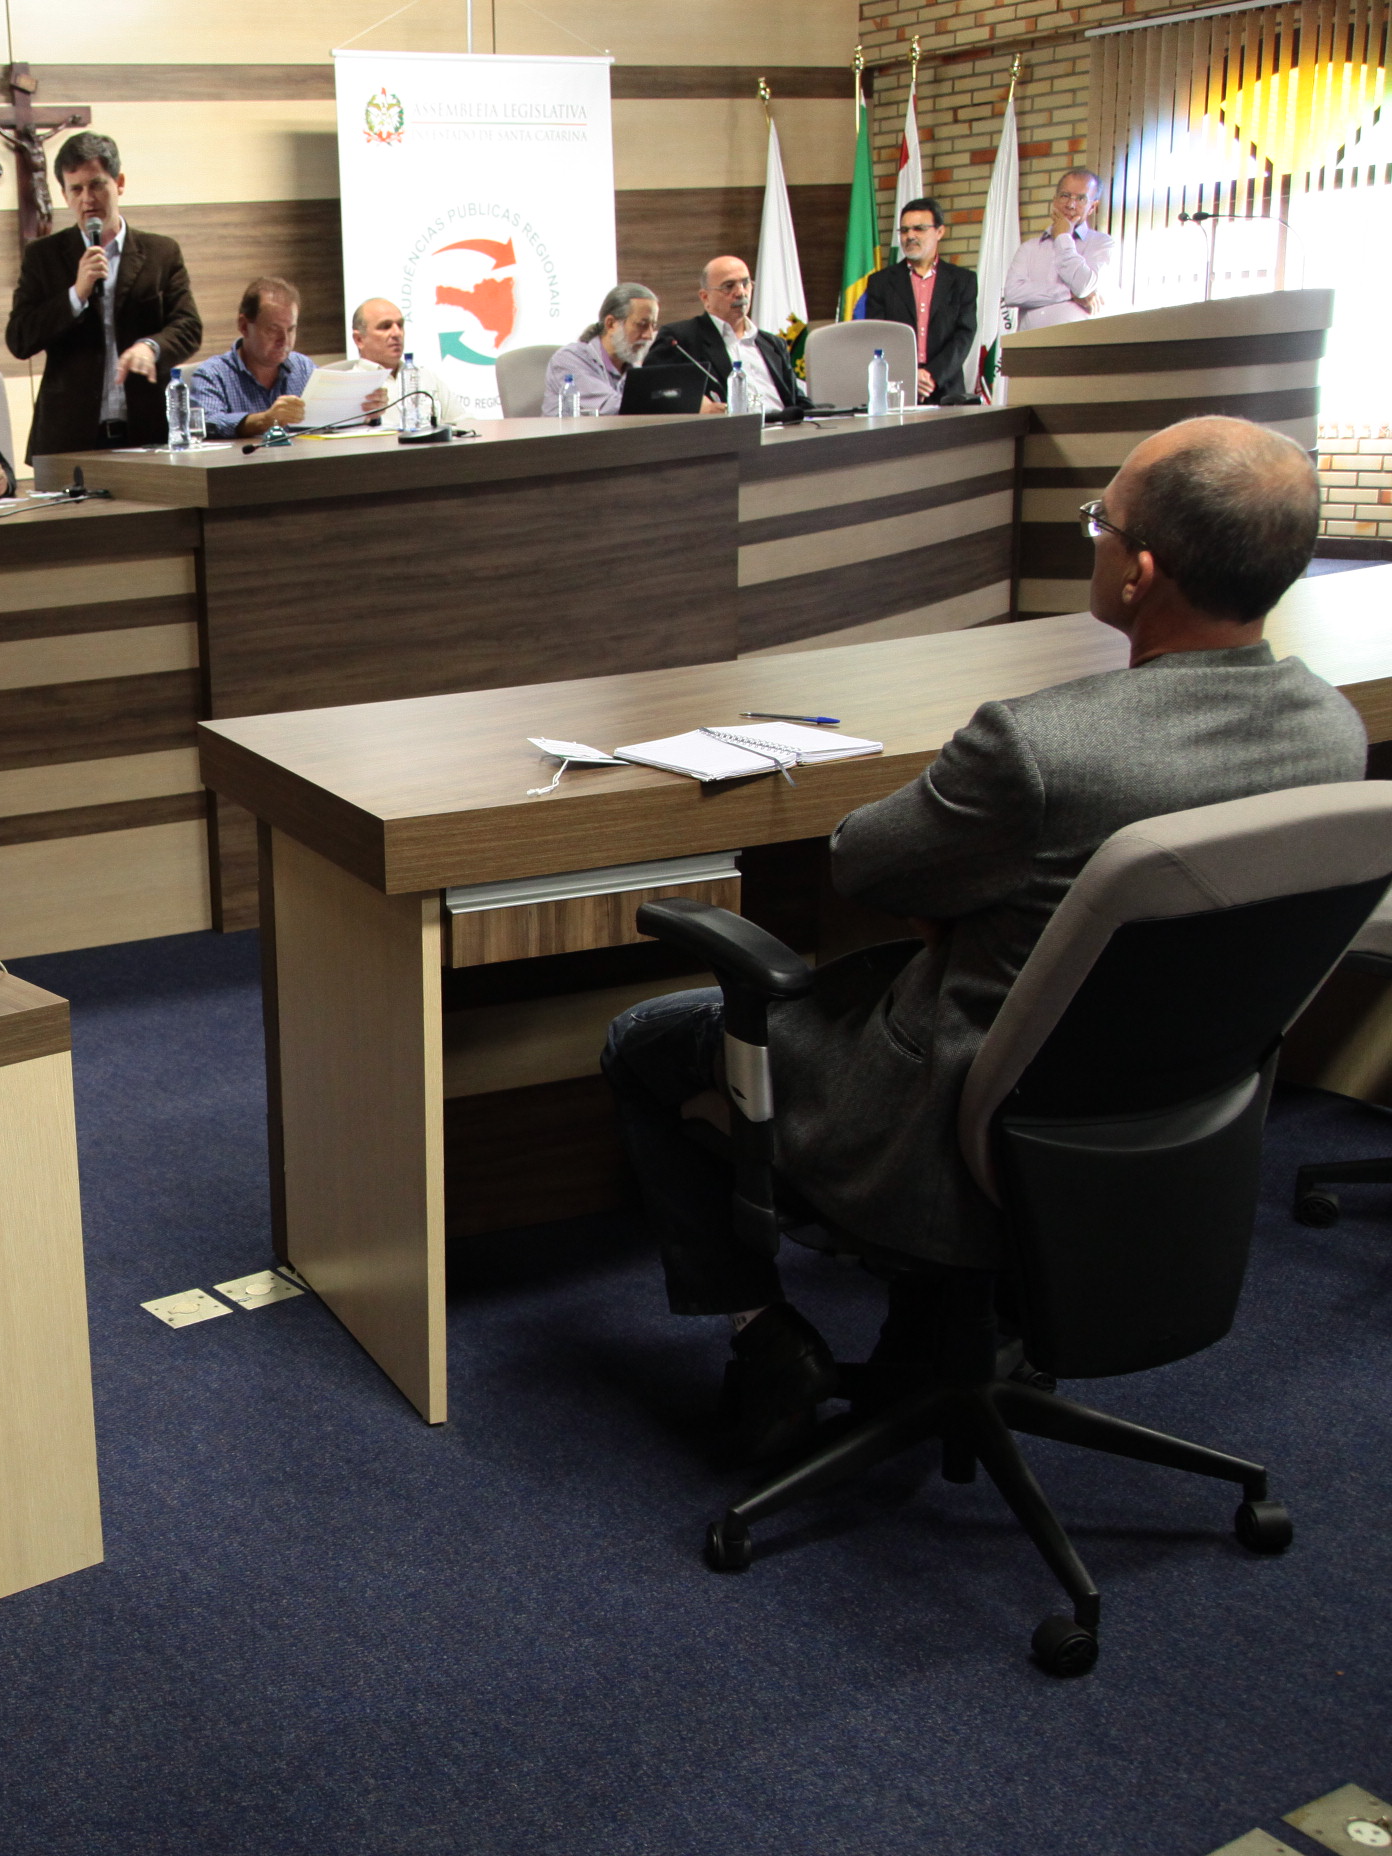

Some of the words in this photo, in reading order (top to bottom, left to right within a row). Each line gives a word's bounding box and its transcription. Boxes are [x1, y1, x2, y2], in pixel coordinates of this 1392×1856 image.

[503, 103, 588, 119] LEGISLATIVA
[498, 129, 532, 142] SANTA
[535, 130, 588, 142] CATARINA
[521, 222, 561, 318] REGIONAIS
